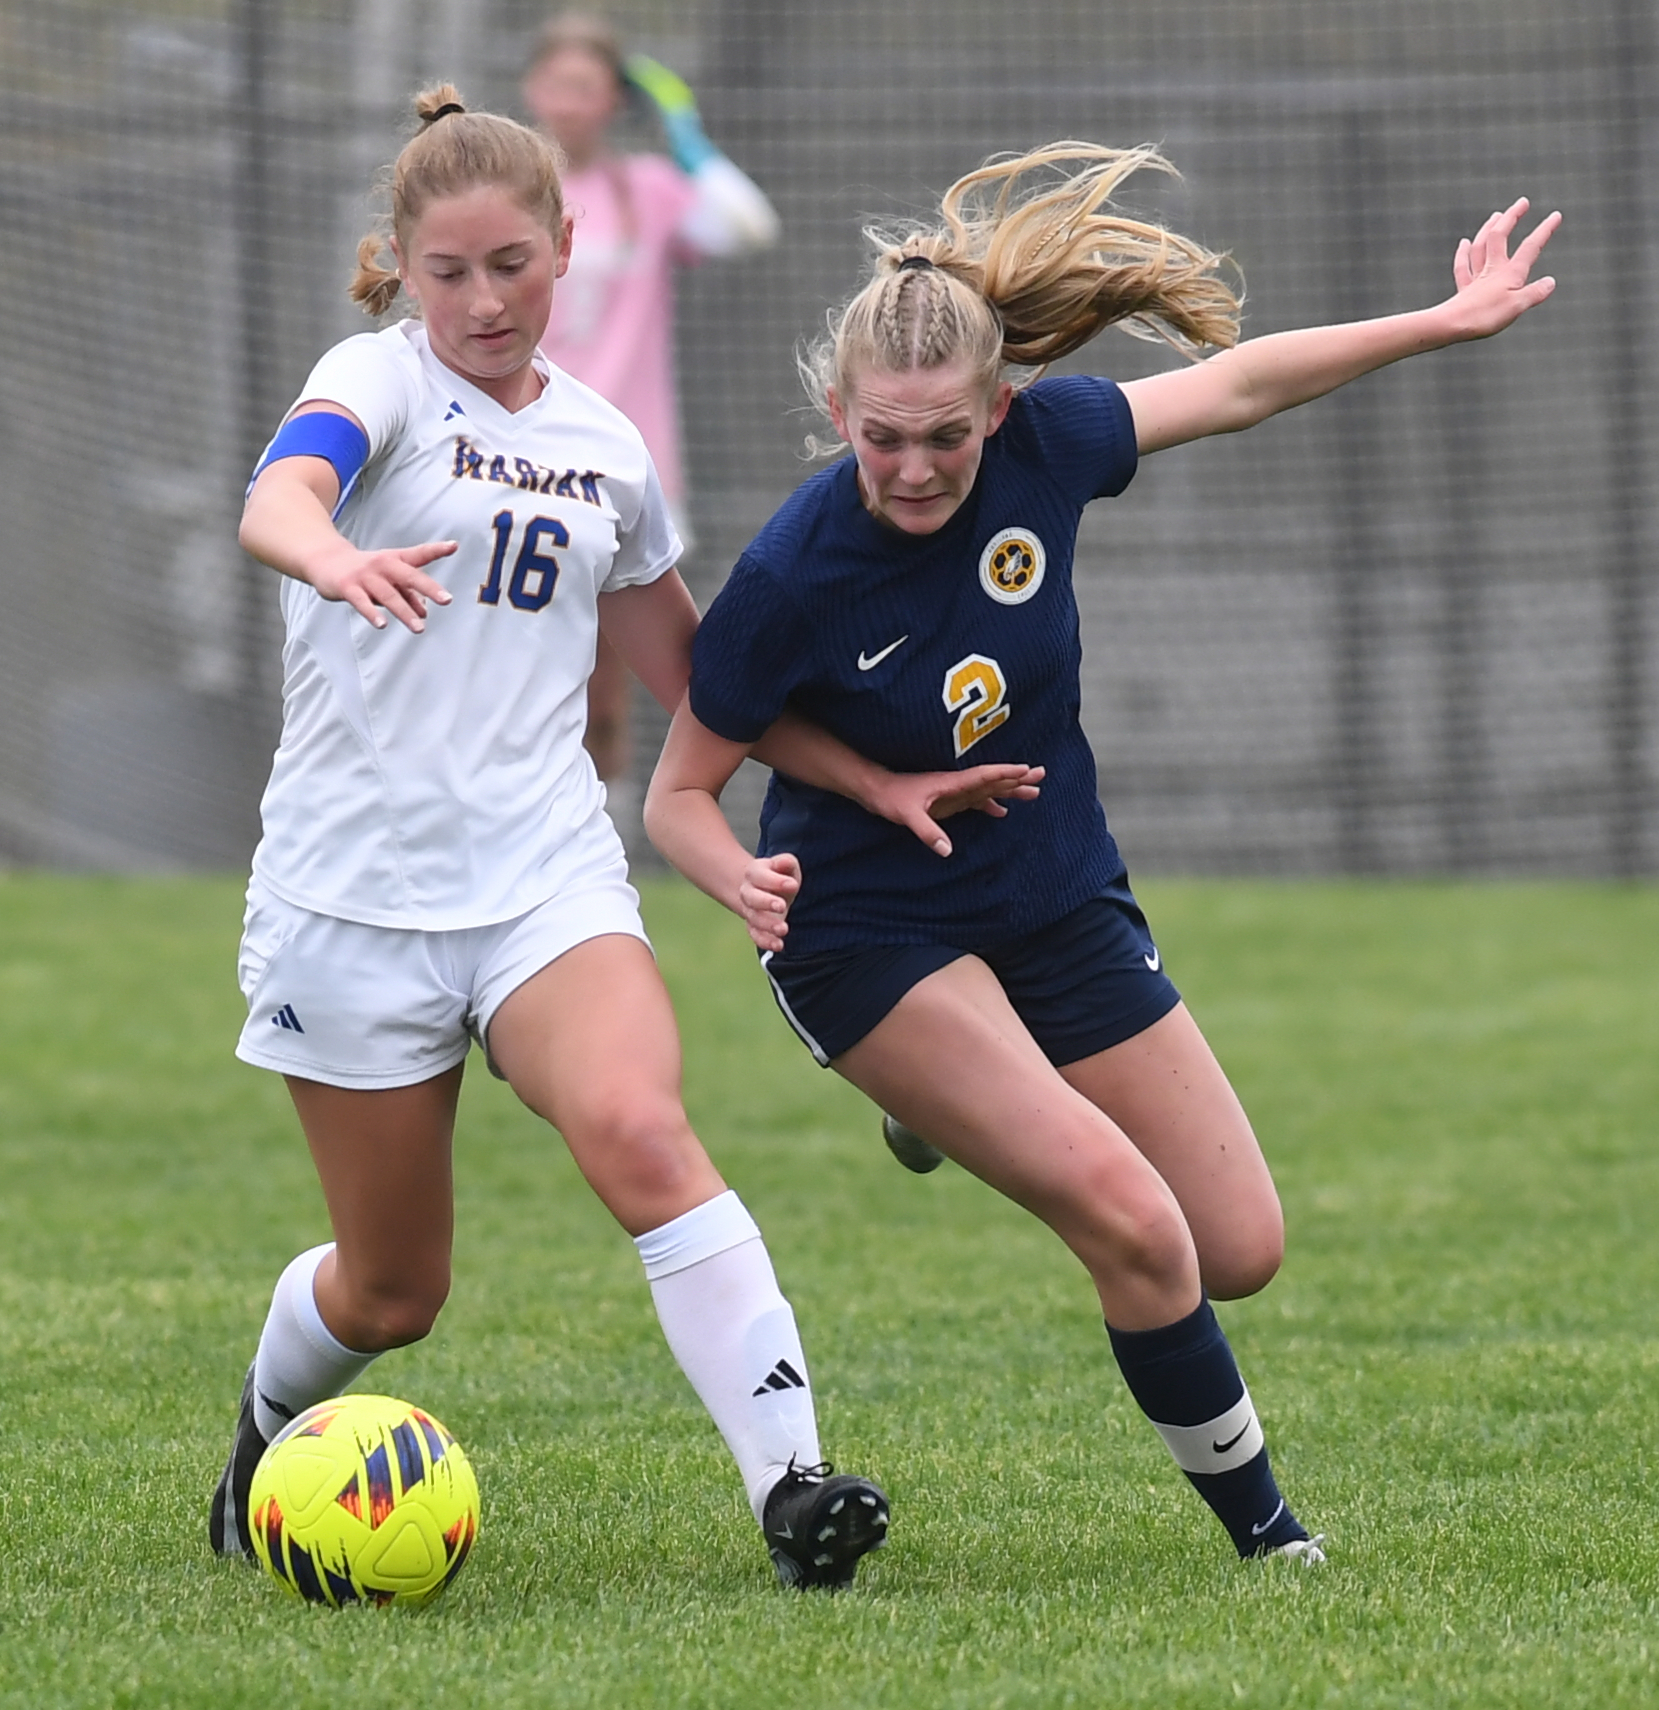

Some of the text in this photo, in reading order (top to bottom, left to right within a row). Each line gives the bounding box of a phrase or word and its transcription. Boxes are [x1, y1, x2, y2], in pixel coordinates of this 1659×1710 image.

[451, 436, 606, 508] MARIAN
[477, 508, 570, 612] 16
[942, 653, 1011, 759] 2
